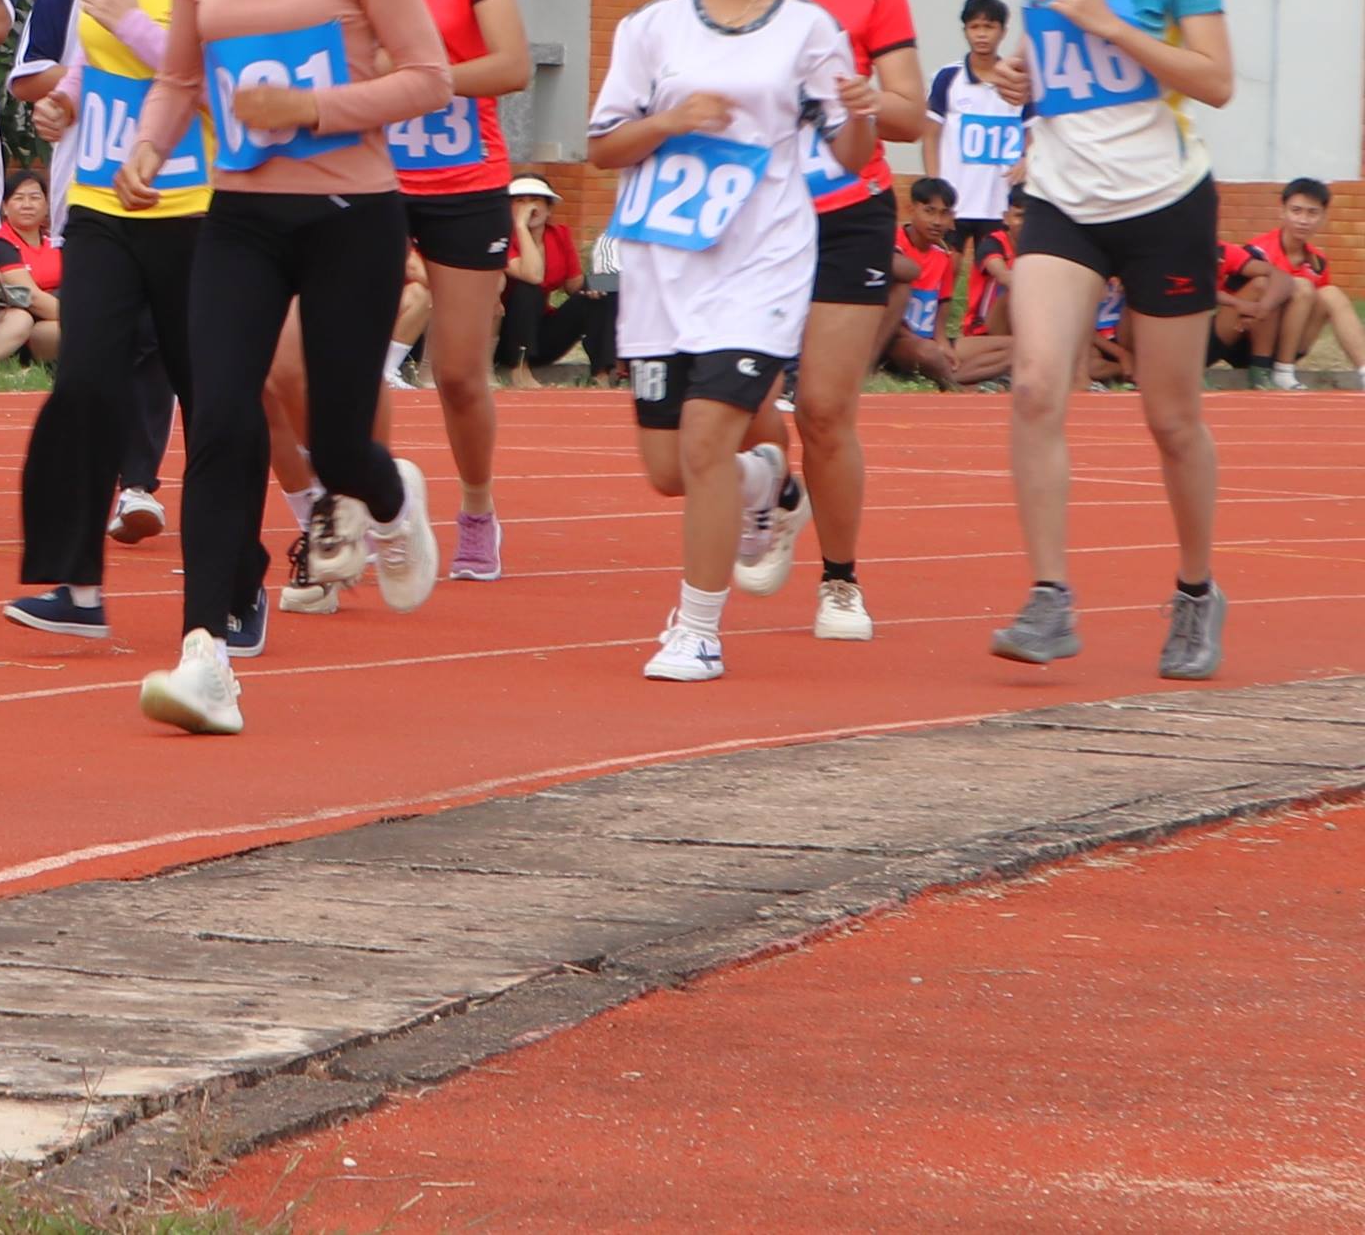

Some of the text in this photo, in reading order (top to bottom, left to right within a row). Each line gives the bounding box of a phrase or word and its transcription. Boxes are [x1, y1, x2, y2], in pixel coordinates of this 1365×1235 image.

[77, 91, 198, 176] 04
[388, 96, 472, 158] 43
[963, 123, 1022, 159] 012
[619, 153, 756, 238] 028
